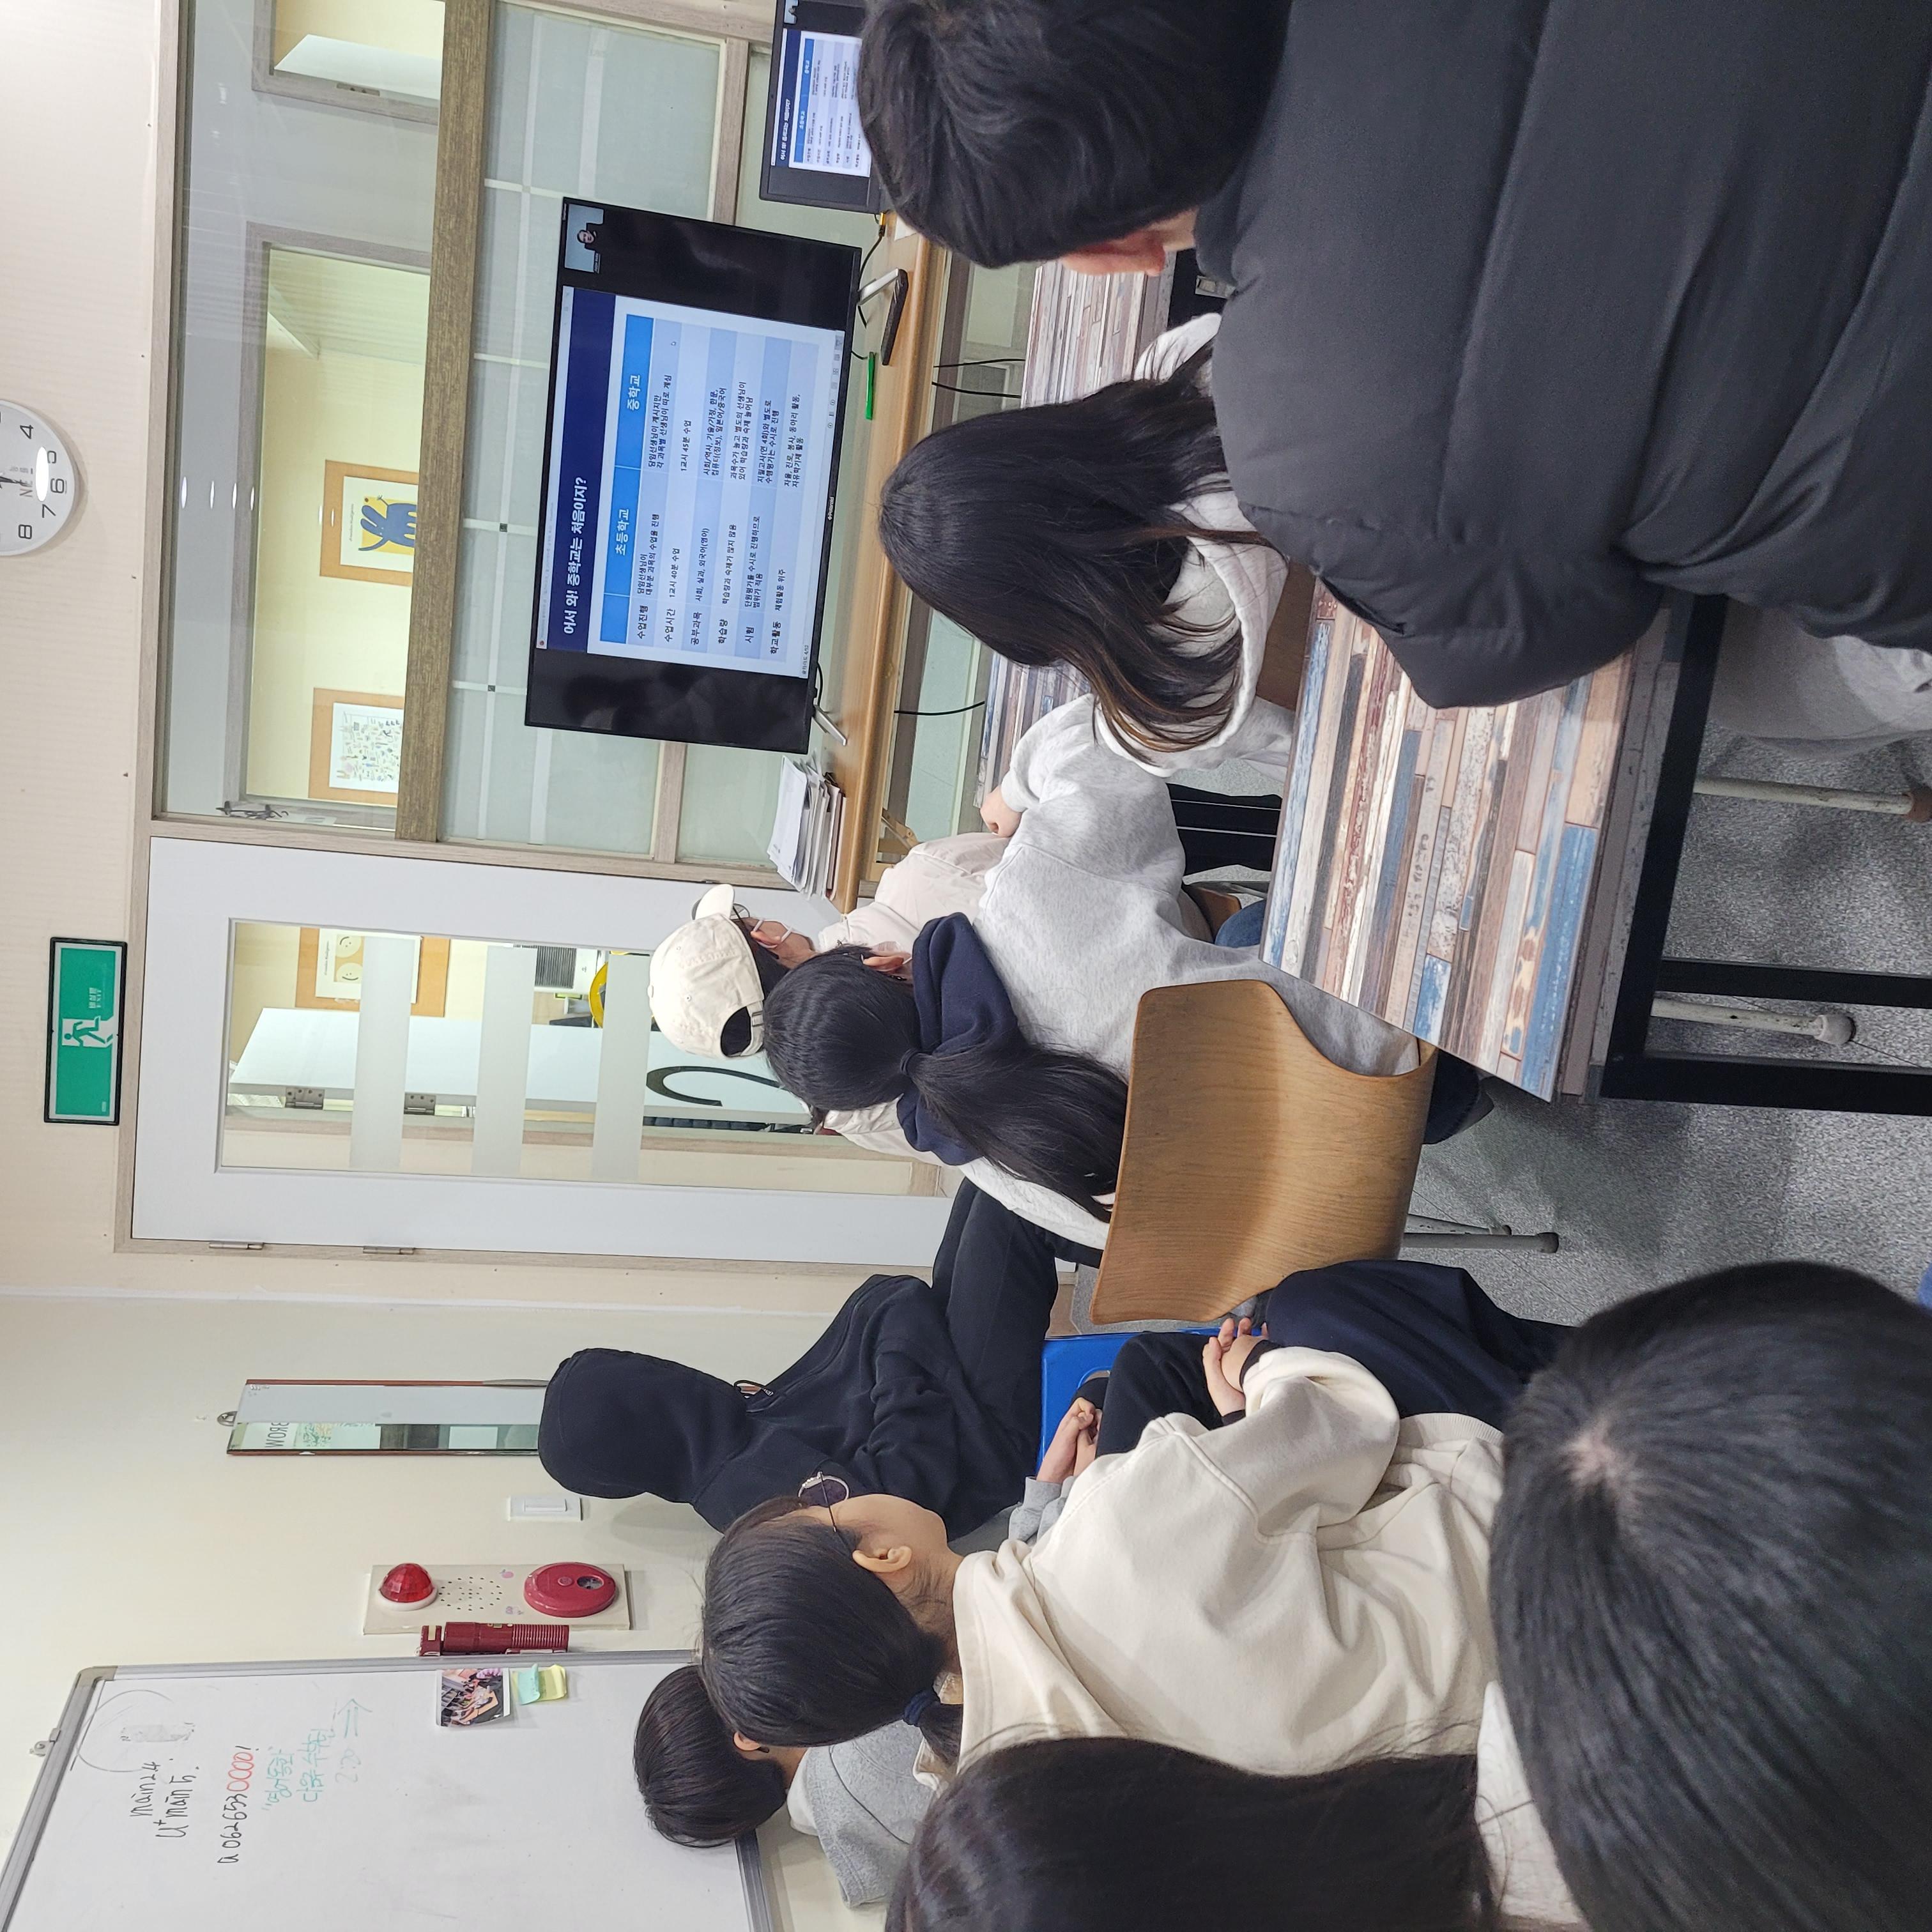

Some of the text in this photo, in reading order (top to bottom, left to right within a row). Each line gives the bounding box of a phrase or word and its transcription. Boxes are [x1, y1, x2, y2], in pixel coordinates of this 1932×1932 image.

[627, 374, 641, 410] 중학교
[662, 392, 670, 406] 따로
[663, 375, 671, 388] 계심
[20, 425, 33, 440] 4
[648, 395, 661, 468] 담임선생님이 계시지만
[660, 408, 668, 436] 선생님이
[703, 390, 718, 475] 사회/역사, 기술/가정, 한문,
[711, 387, 726, 476] 컴퓨터(정보), 일본어/중국어
[730, 381, 746, 479] 과목수가 늘고 별도의 선생님이
[739, 397, 753, 480] 있어 학습량과 숙제 늘어남
[757, 400, 772, 483] 지필고사(연 4회)와 별도로
[784, 394, 801, 486] 자율, 진로, 봉사, 동아리 활동,
[657, 438, 666, 459] 과목별
[680, 420, 691, 471] 1교시 45분 수업
[765, 449, 776, 484] 수행평가는
[771, 410, 779, 424] 진행
[792, 437, 804, 487] 자유학기제 활동
[50, 478, 64, 493] 6
[42, 504, 56, 518] 7
[19, 525, 32, 539] 8
[615, 509, 629, 555] 초등학교
[564, 477, 587, 634] 어서 와! 중학교는 처음이지?
[638, 554, 648, 594] 담임선생님이
[645, 514, 659, 595] 대부분 과목의 수업을 진행
[672, 548, 680, 562] 수업
[695, 528, 709, 601] 사회, 실과, 외국어(영어)
[722, 524, 737, 604] 학습량과 숙제가 많지 않음
[745, 516, 760, 607] 단원평가를 수시로 진행하므로
[753, 588, 762, 608] 범위가
[774, 569, 786, 611] 체험활동 위주
[638, 605, 648, 639] 수업진행
[664, 608, 676, 642] 수업시간
[691, 612, 702, 645] 공부과목
[718, 618, 728, 644] 학습량
[745, 626, 755, 643] 시험
[770, 621, 781, 654] 학교활동
